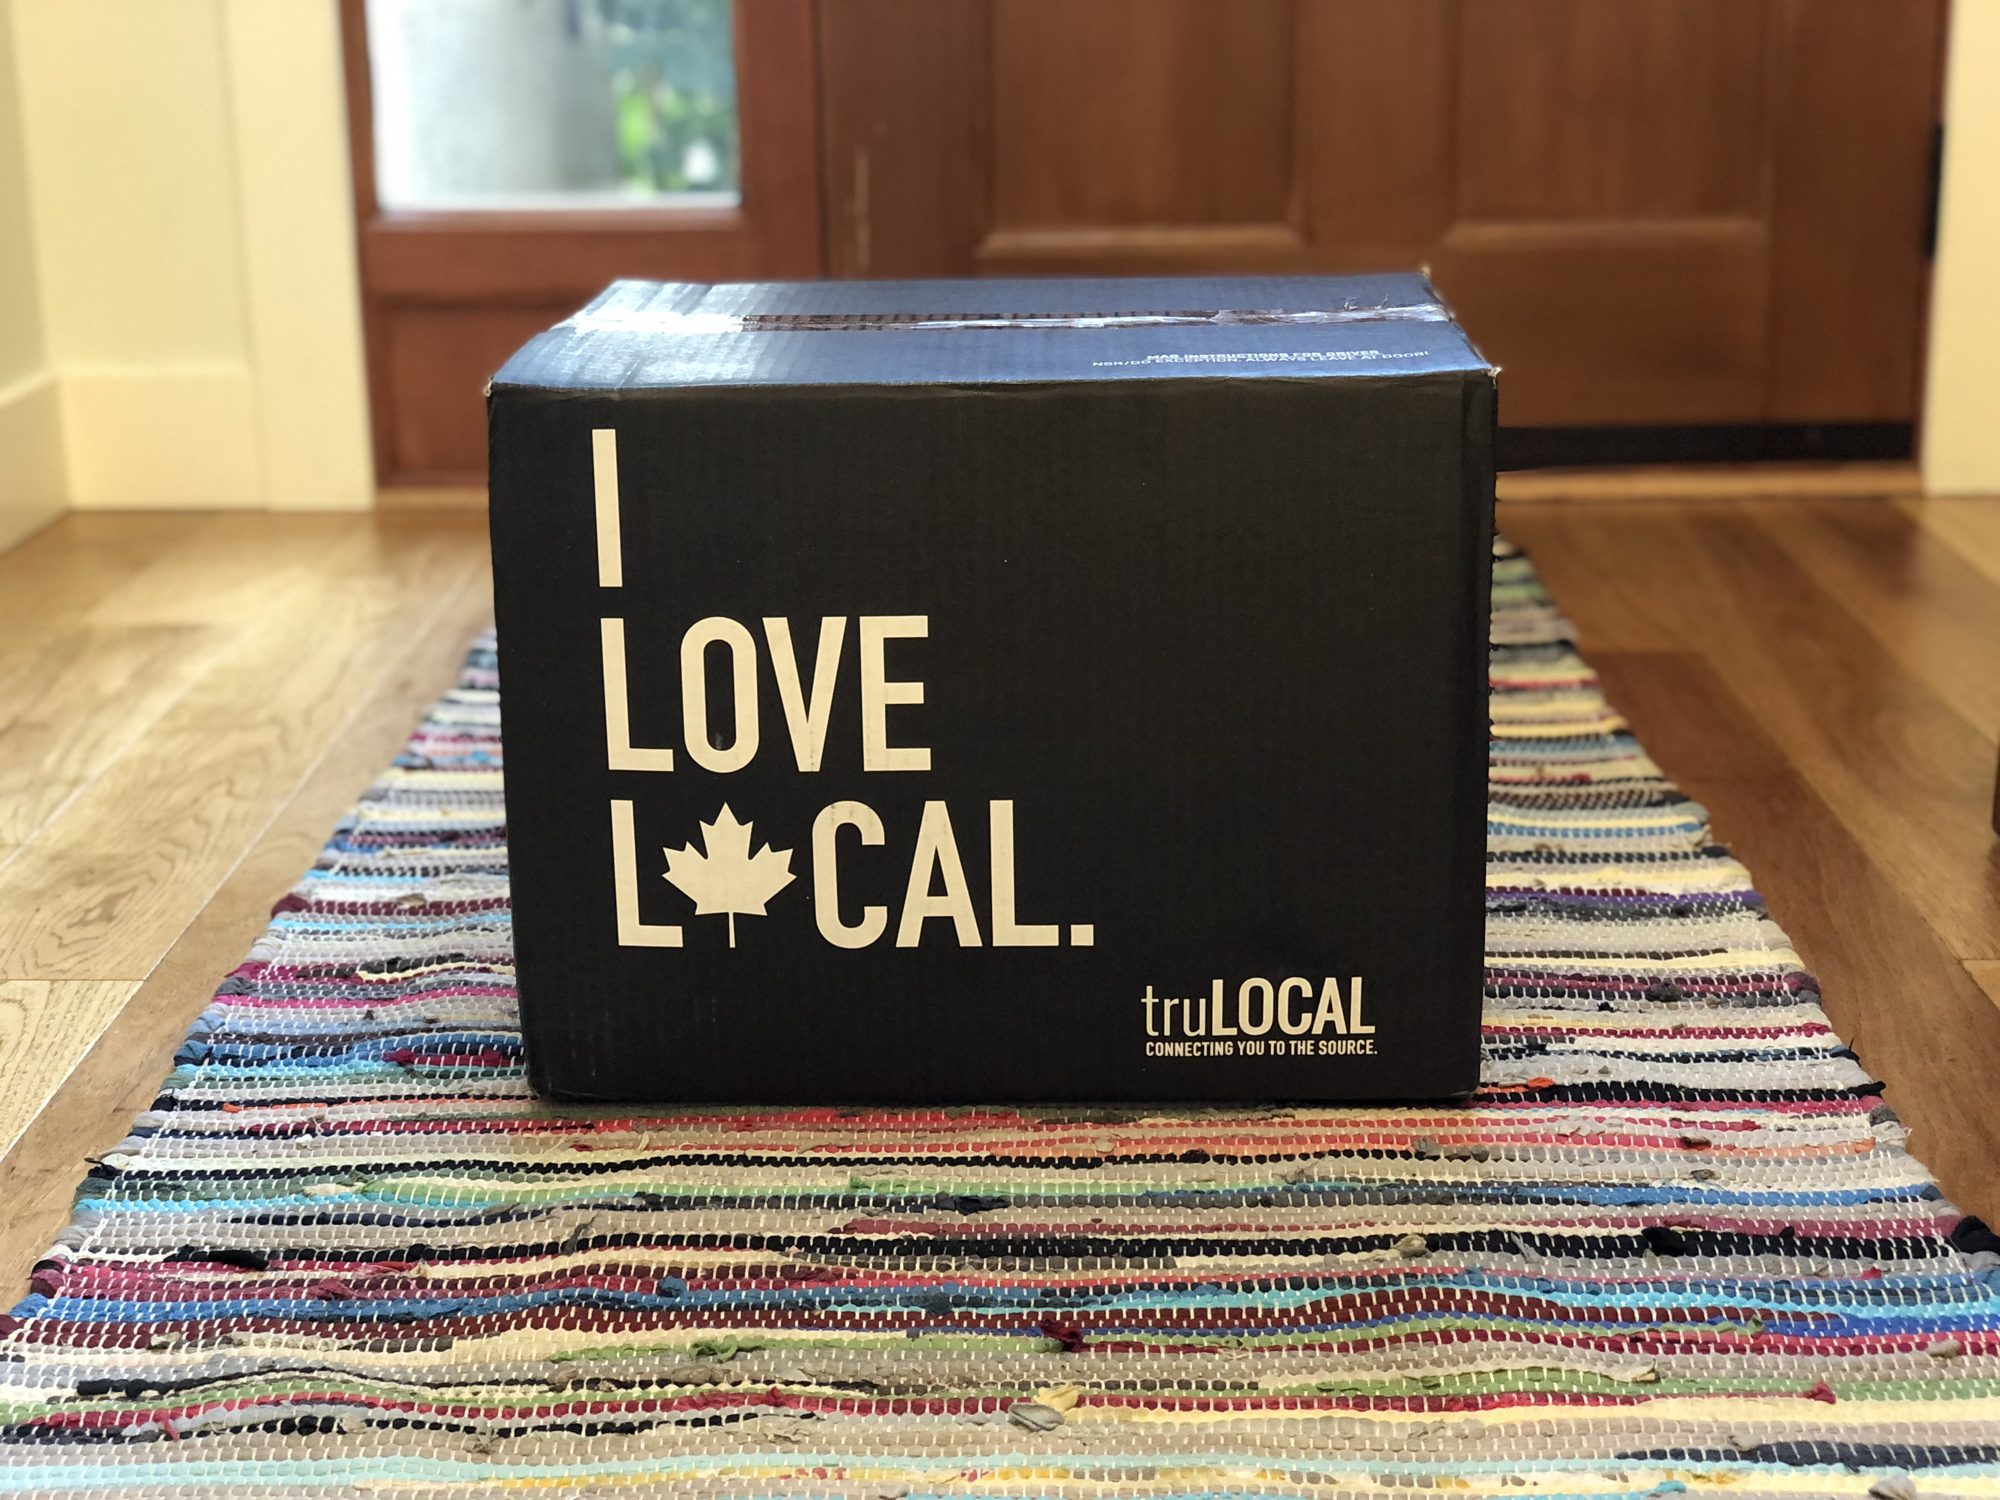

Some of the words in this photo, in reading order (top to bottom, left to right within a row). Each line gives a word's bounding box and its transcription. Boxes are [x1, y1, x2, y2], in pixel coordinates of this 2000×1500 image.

[591, 428, 623, 588] I
[600, 614, 932, 774] LOVE
[1140, 976, 1376, 1037] truLOCAL
[1145, 1040, 1234, 1057] CONNECTING
[1237, 1040, 1265, 1056] YOU
[1268, 1040, 1286, 1056] TO
[1288, 1039, 1315, 1056] THE
[1318, 1039, 1378, 1055] SOURCE.
